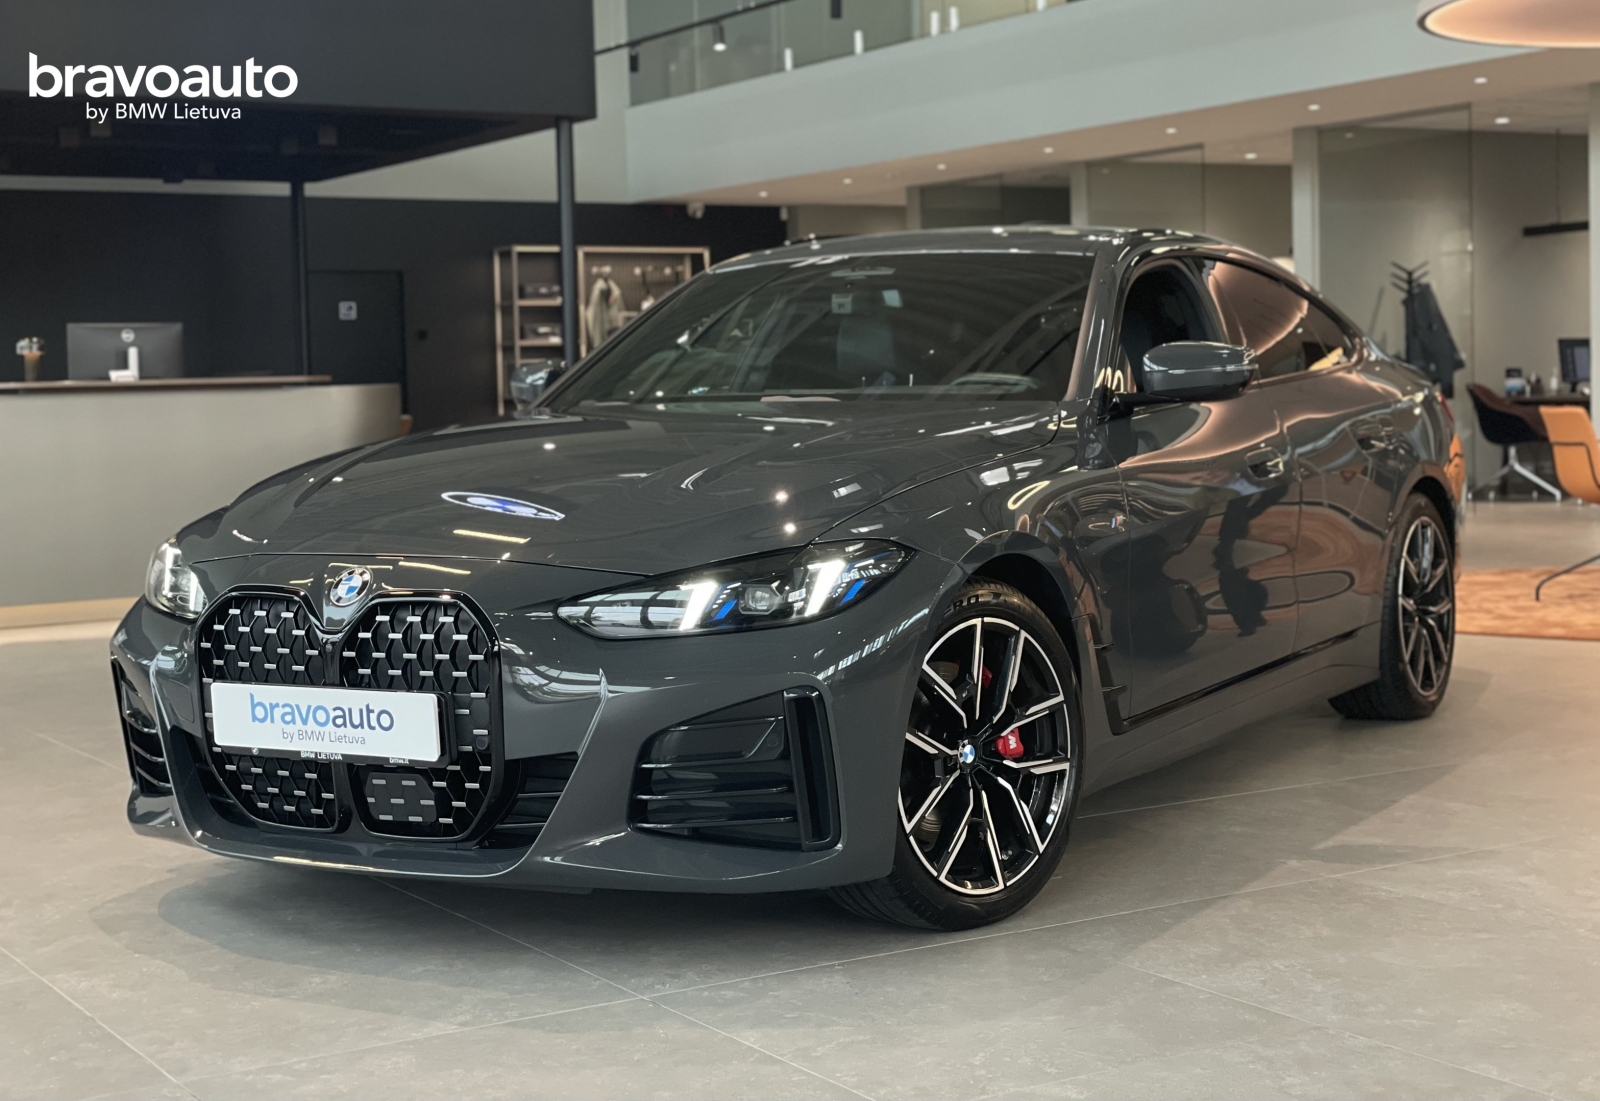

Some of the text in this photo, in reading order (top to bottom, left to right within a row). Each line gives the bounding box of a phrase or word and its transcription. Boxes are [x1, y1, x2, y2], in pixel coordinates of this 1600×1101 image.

[249, 692, 395, 732] bravoauto
[282, 728, 366, 745] by BMW Lietuva
[300, 751, 342, 761] BMW LIETUVA
